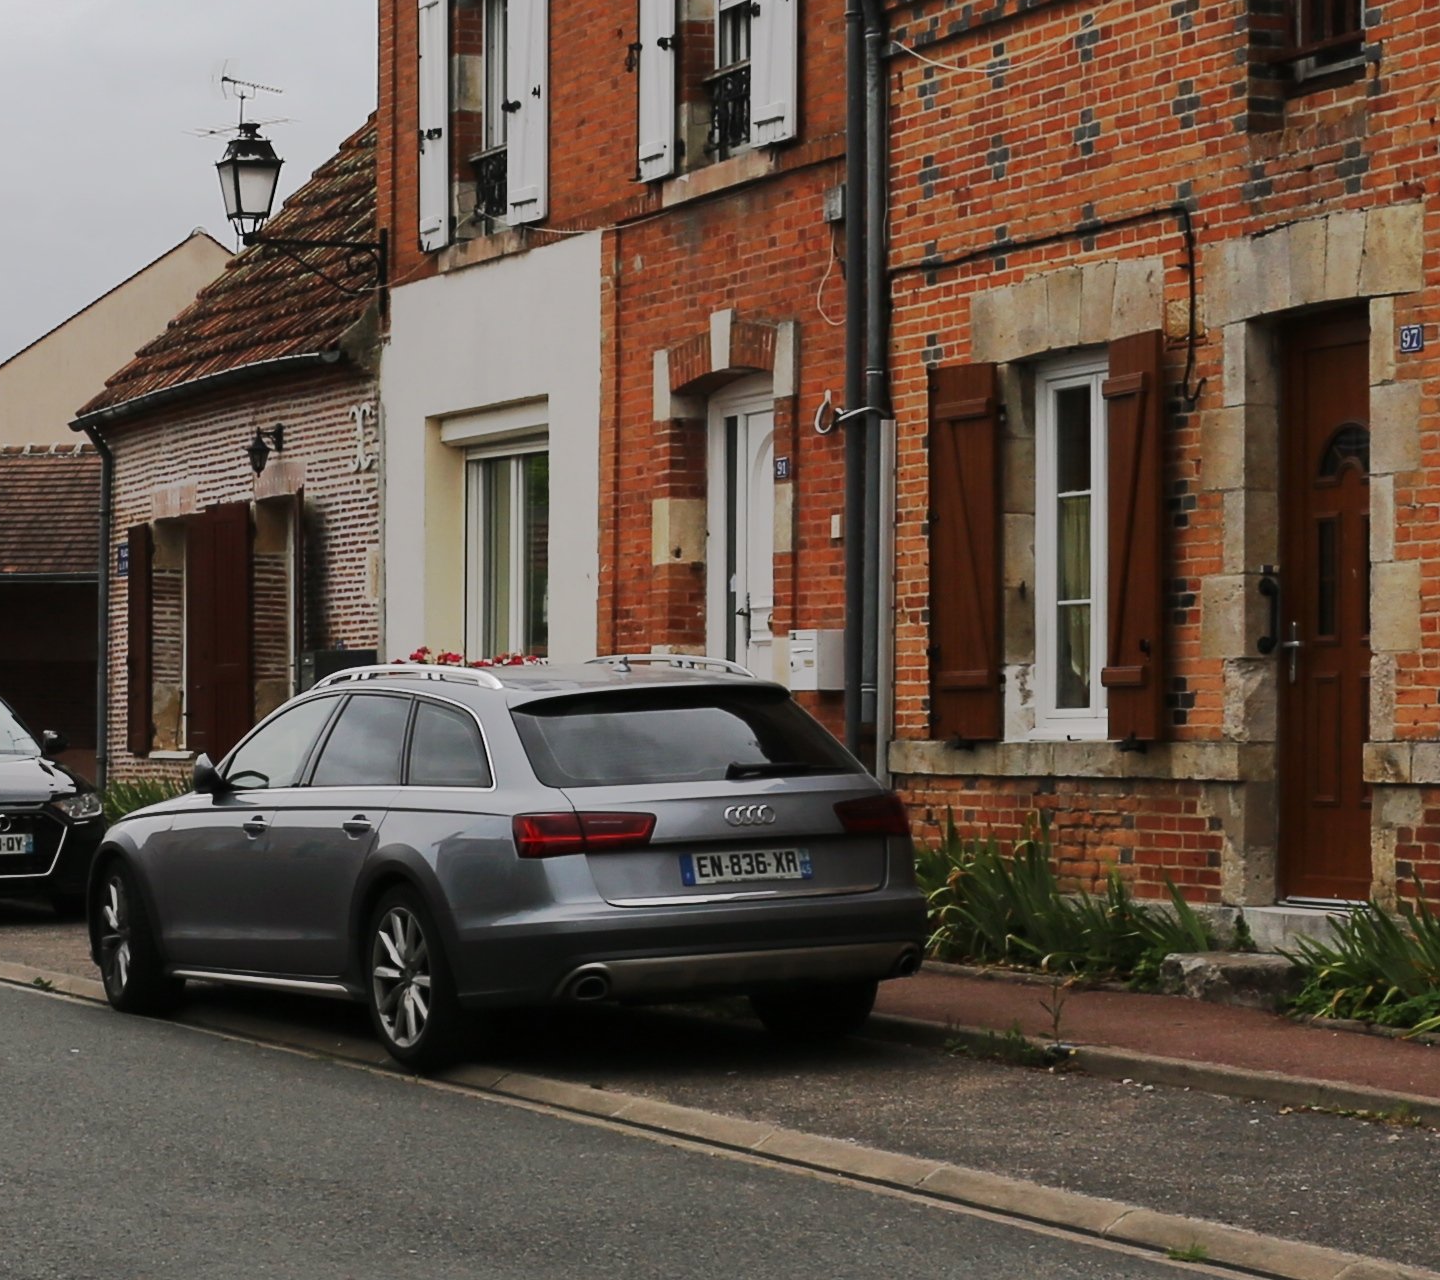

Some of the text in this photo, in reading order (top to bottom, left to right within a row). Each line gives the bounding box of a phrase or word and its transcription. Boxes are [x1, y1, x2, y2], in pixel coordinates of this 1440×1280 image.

[1402, 329, 1418, 348] 97
[777, 461, 786, 475] 91
[696, 851, 799, 878] EN-836-XR
